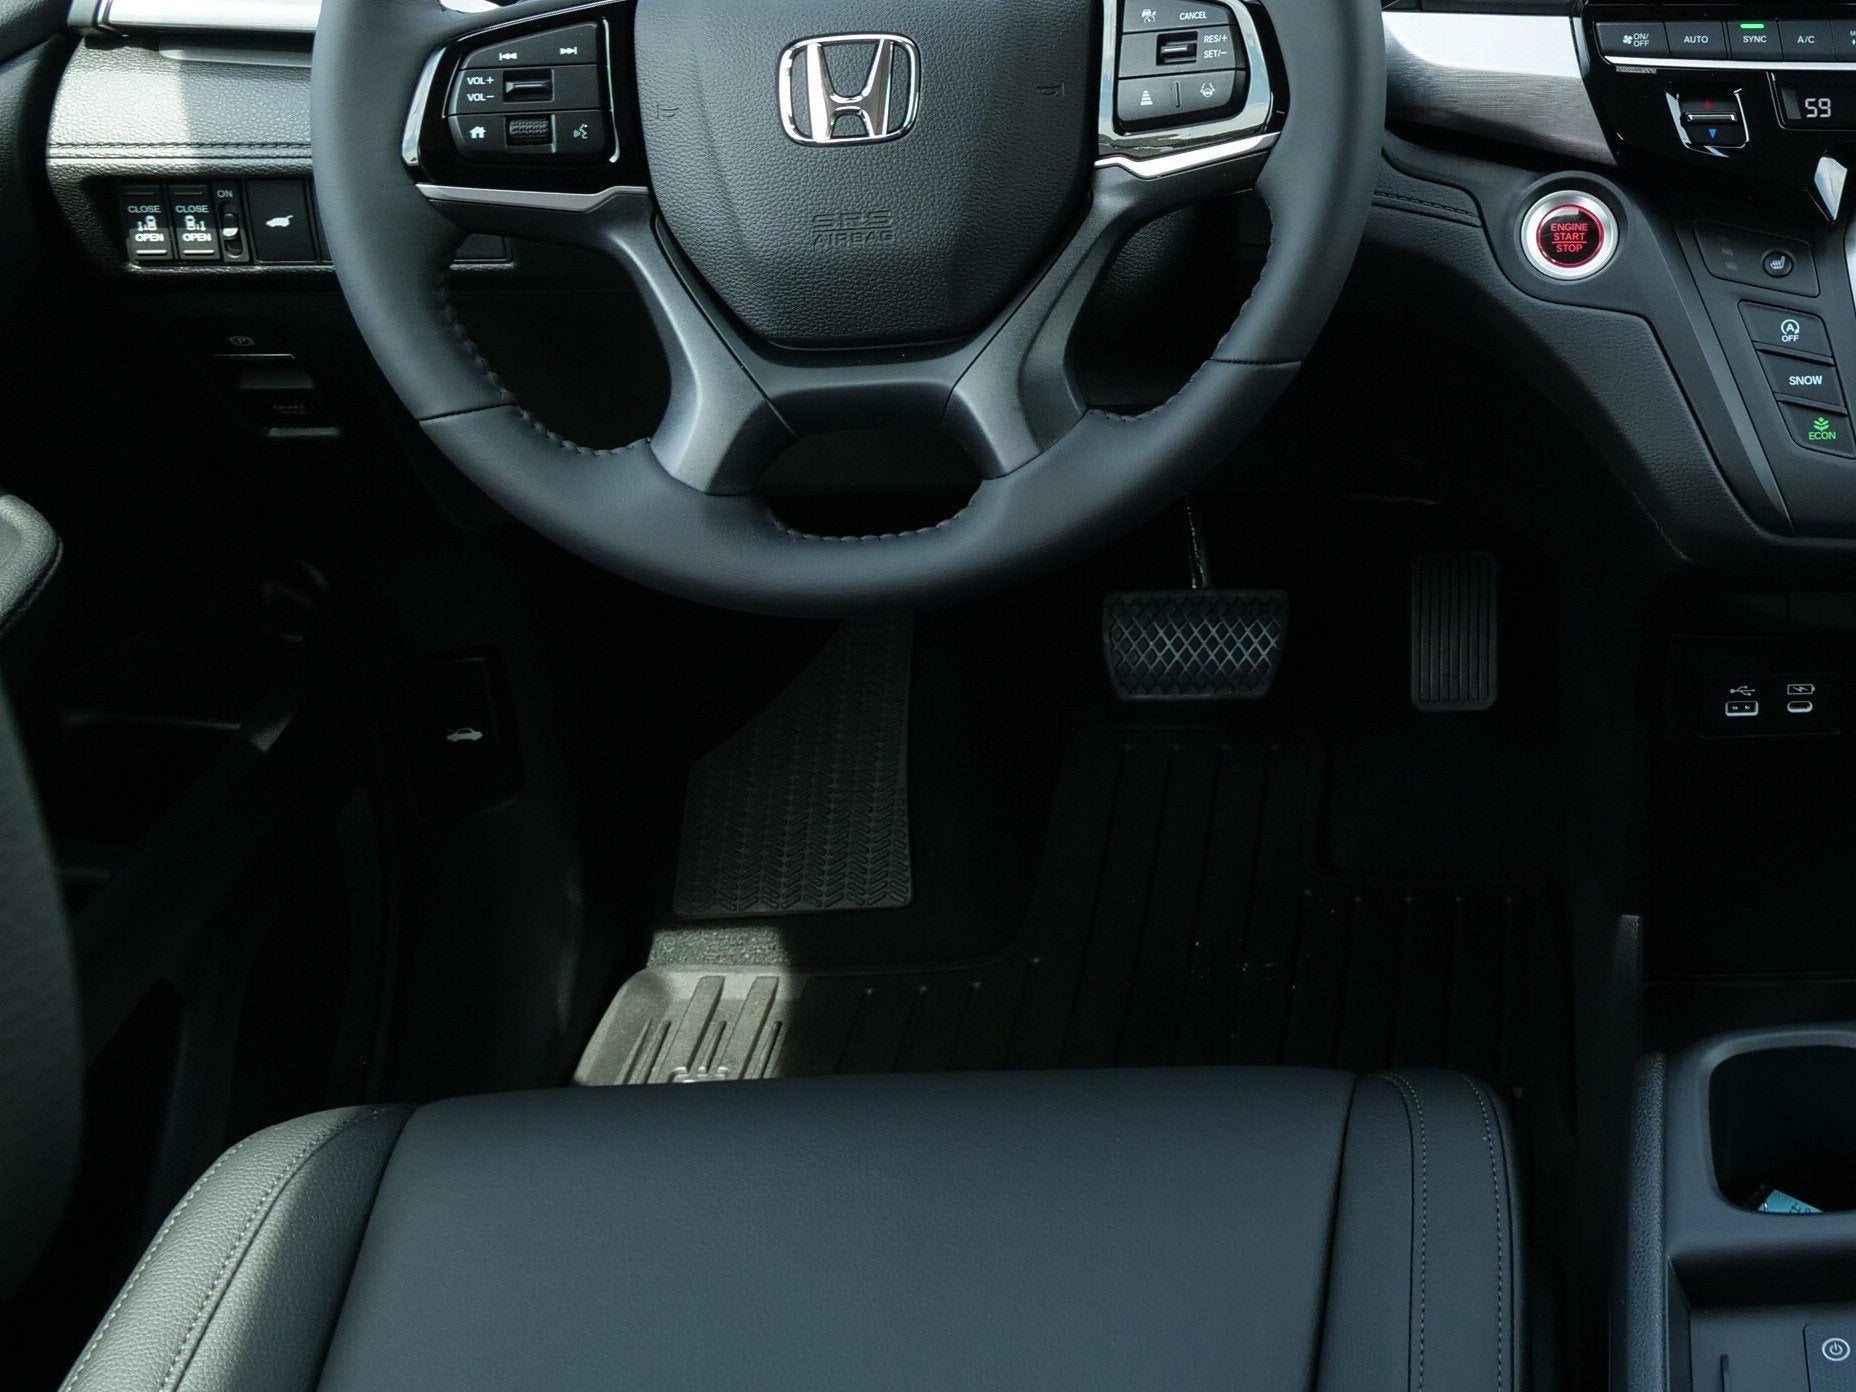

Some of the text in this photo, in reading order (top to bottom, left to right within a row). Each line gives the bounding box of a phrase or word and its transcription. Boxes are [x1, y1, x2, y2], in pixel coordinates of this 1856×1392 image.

[1180, 11, 1207, 20] CANCEL
[1204, 34, 1227, 43] RES/+
[1798, 36, 1814, 44] A/C
[1805, 98, 1831, 118] 59
[217, 190, 233, 198] ON
[175, 205, 209, 213] CLOSE
[813, 210, 892, 228] SRS
[1551, 223, 1588, 231] ENGINE
[135, 233, 164, 242] OPEN
[183, 233, 212, 241] OPEN
[813, 231, 895, 245] AIRBAG
[1556, 244, 1582, 252] STOP
[1789, 376, 1822, 385] SNOW
[1808, 432, 1836, 440] ECON
